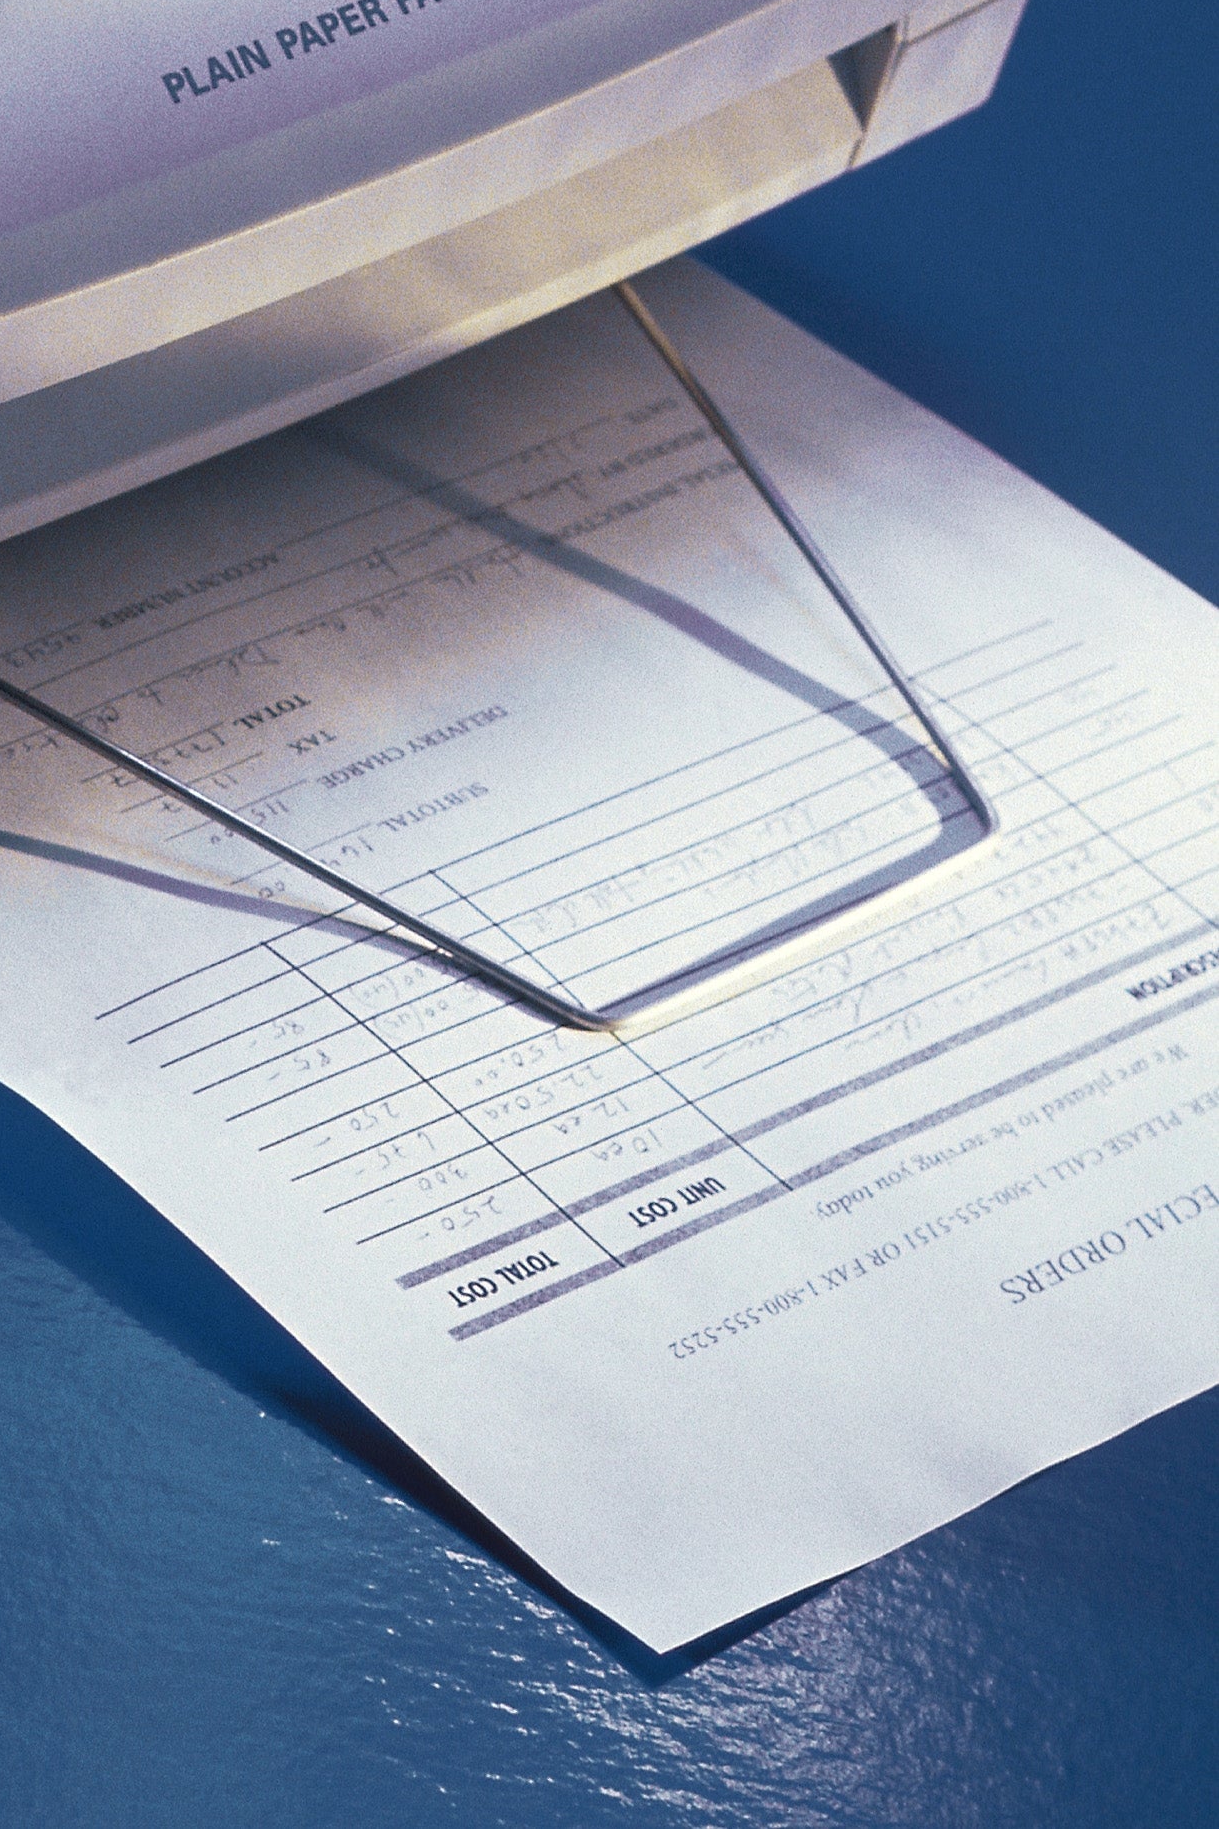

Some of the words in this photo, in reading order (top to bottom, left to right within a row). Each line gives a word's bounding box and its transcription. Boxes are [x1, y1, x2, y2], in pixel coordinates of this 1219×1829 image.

[161, 39, 272, 104] PLAIN
[183, 554, 280, 595] ACCOUNT
[93, 590, 184, 631] NUMBER
[232, 693, 312, 732] TOTAL
[407, 704, 508, 754] DELIVERY
[285, 729, 337, 757] TAX
[316, 744, 406, 791] CHARGE
[378, 780, 491, 832] SUBTOTAL
[1124, 947, 1219, 1001] SCRIPTION
[1042, 1070, 1115, 1122] pleased
[1018, 1110, 1040, 1128] to
[1103, 1110, 1184, 1157] PLEASE
[914, 1131, 985, 1173] serving
[1045, 1149, 1104, 1181] CALL
[678, 1174, 727, 1206] UNIT
[874, 1160, 915, 1196] you
[626, 1195, 679, 1228] COST
[902, 1173, 1047, 1251] 1-800-555-5151
[493, 1249, 560, 1287] TOTAL
[821, 1257, 867, 1289] FAX
[866, 1240, 901, 1268] OR
[999, 1230, 1127, 1305] ORDERS
[446, 1275, 500, 1308] COST
[667, 1279, 819, 1360] 1-800-555-5252
